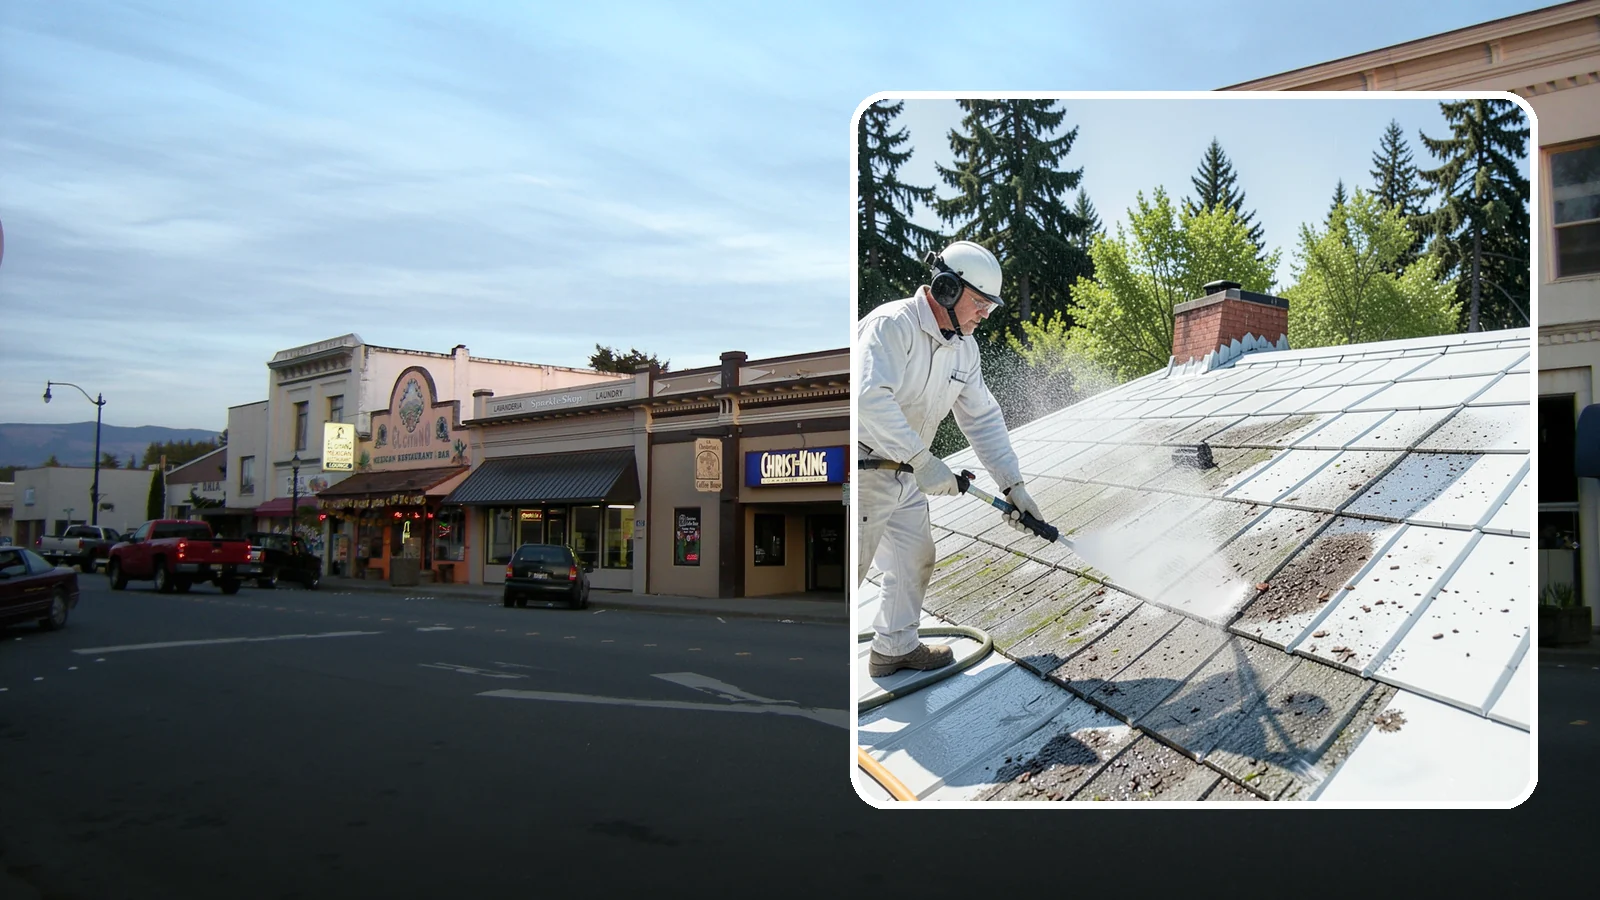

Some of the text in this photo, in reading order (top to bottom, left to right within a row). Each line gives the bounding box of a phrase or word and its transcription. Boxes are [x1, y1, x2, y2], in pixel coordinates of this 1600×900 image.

[595, 389, 623, 400] LAUNDRY
[493, 401, 522, 412] LAVANDERIA
[373, 450, 450, 464] MEXICAN RESTAURANT BAR
[761, 450, 827, 478] CHRIST KING
